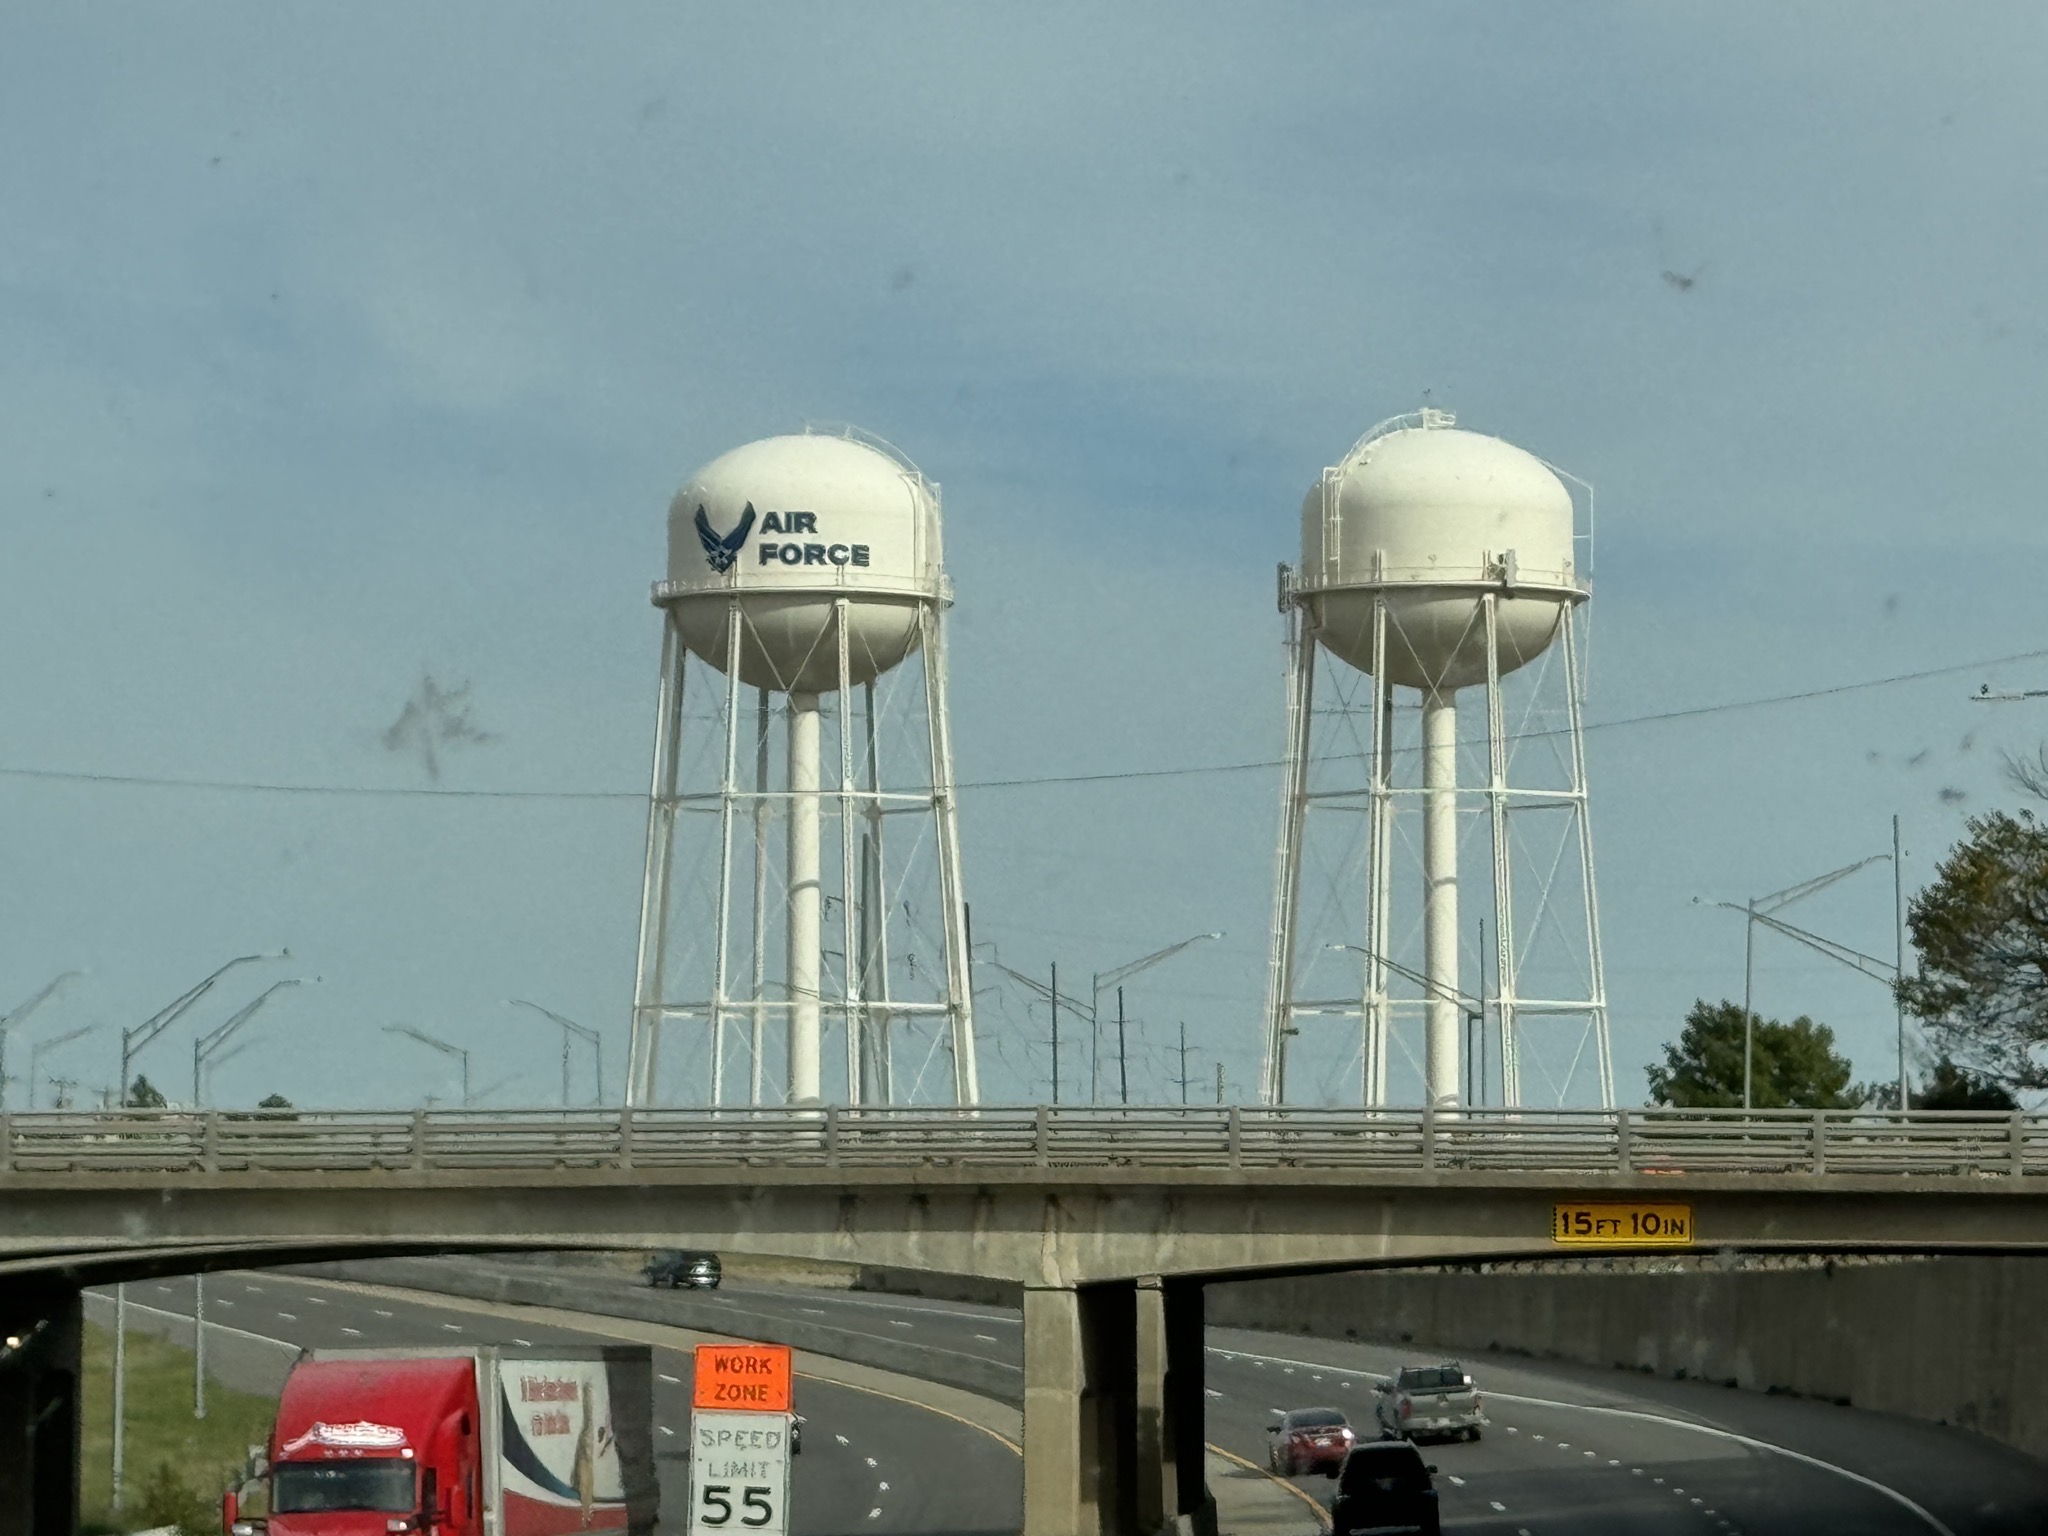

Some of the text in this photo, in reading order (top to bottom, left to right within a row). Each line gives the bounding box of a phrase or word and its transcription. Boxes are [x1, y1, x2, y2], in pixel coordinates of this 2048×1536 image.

[759, 511, 818, 534] AIR
[759, 543, 870, 567] FORCE
[715, 1354, 772, 1375] WORK
[714, 1383, 768, 1402] ZONE
[700, 1428, 781, 1451] SPEED
[708, 1461, 770, 1478] LIMIT
[701, 1484, 772, 1526] 55
